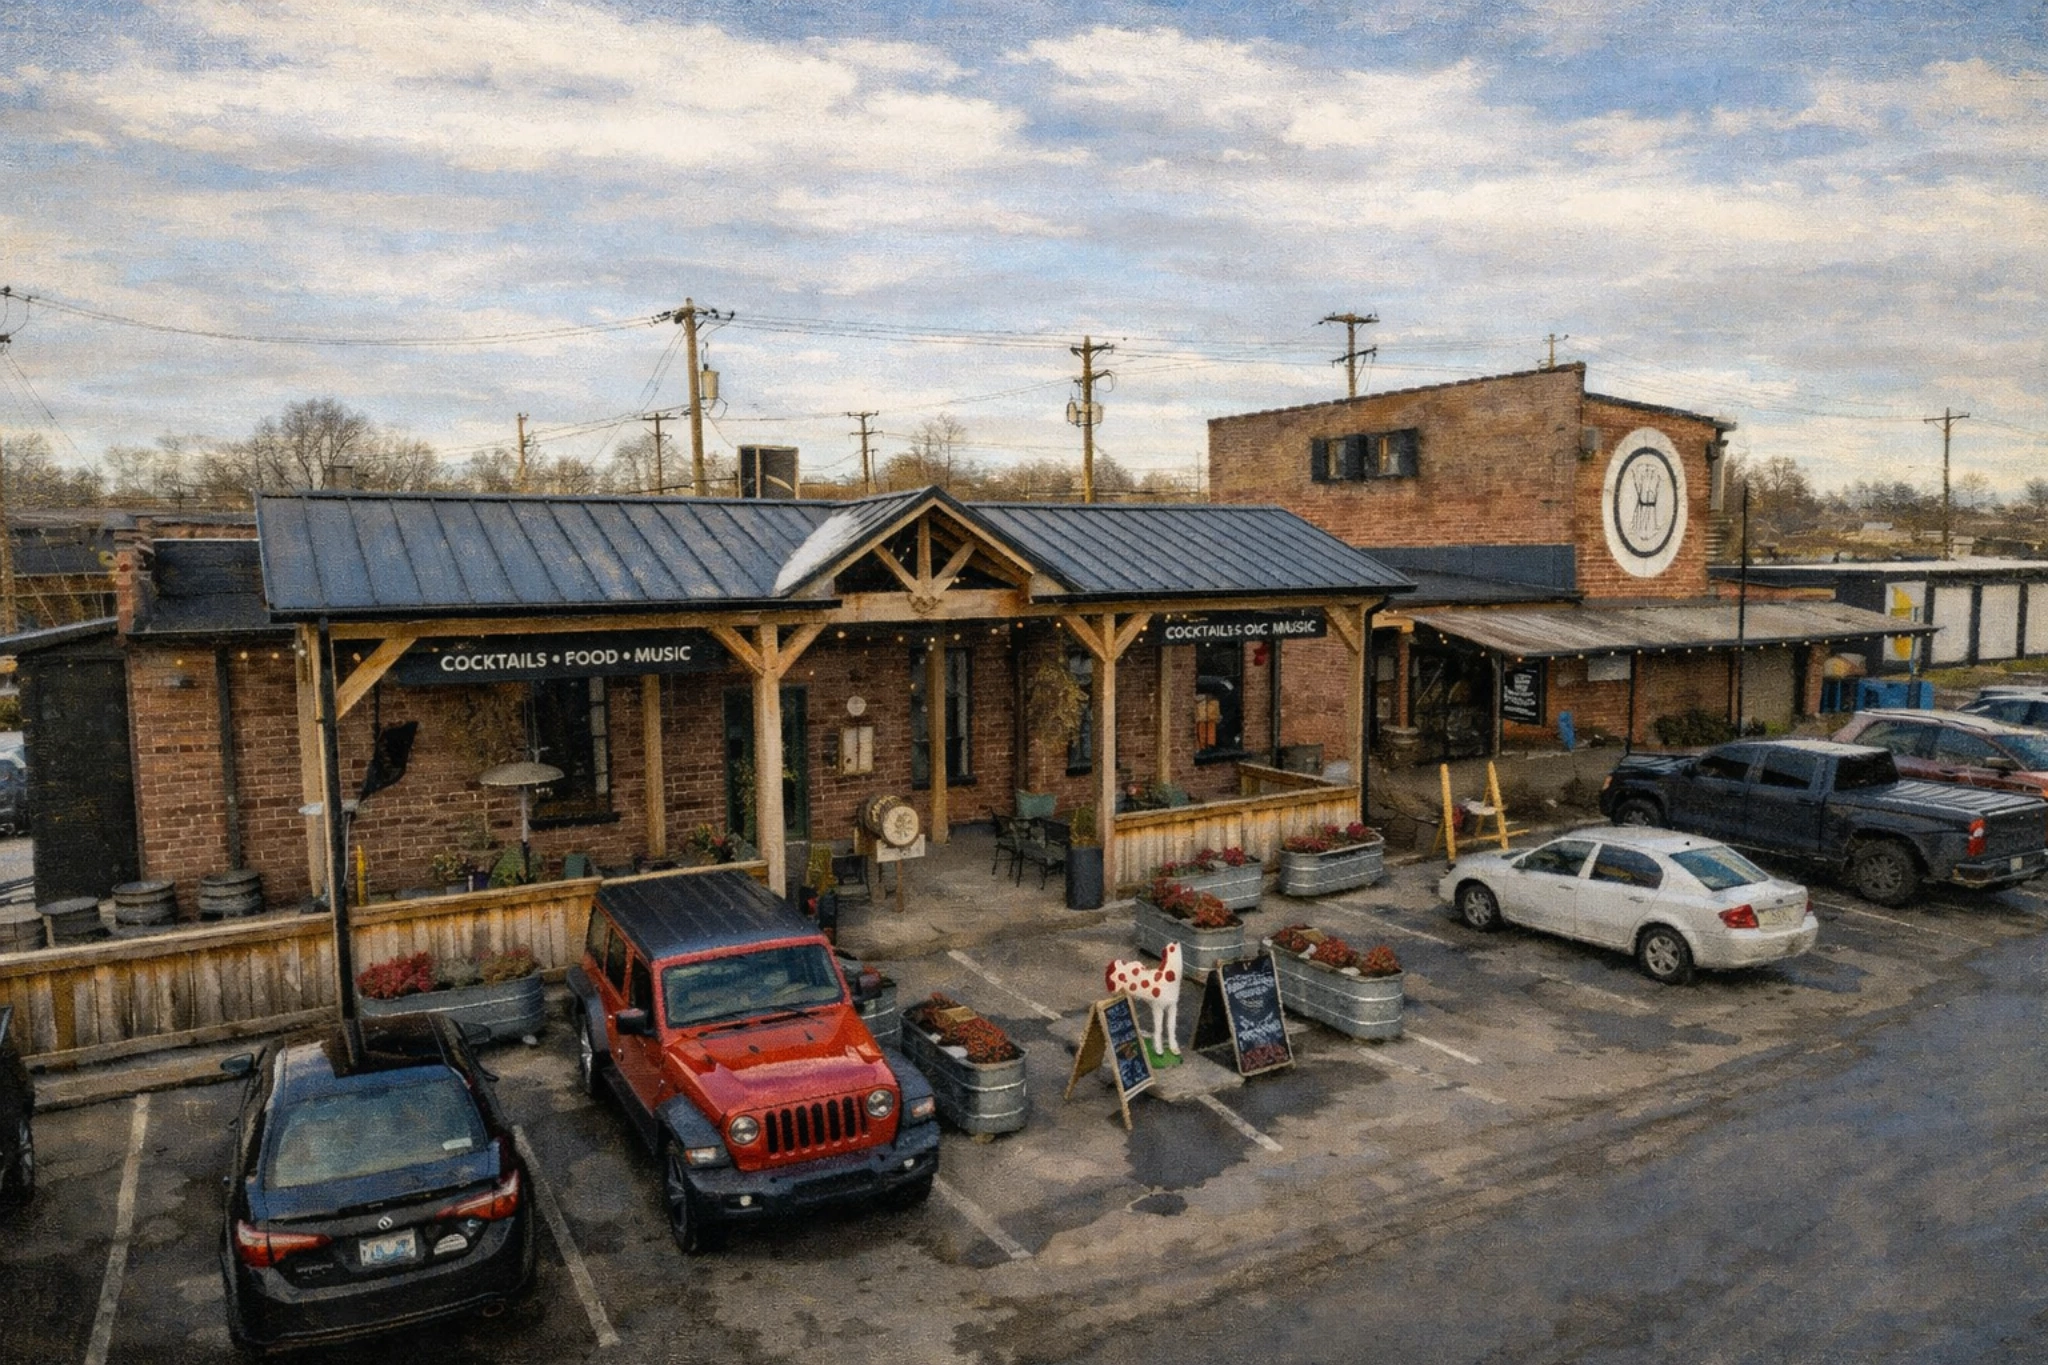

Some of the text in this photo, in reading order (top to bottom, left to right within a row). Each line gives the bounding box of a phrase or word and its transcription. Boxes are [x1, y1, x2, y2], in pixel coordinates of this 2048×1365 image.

[441, 646, 691, 671] COCKTAILS FOOD MUSIC
